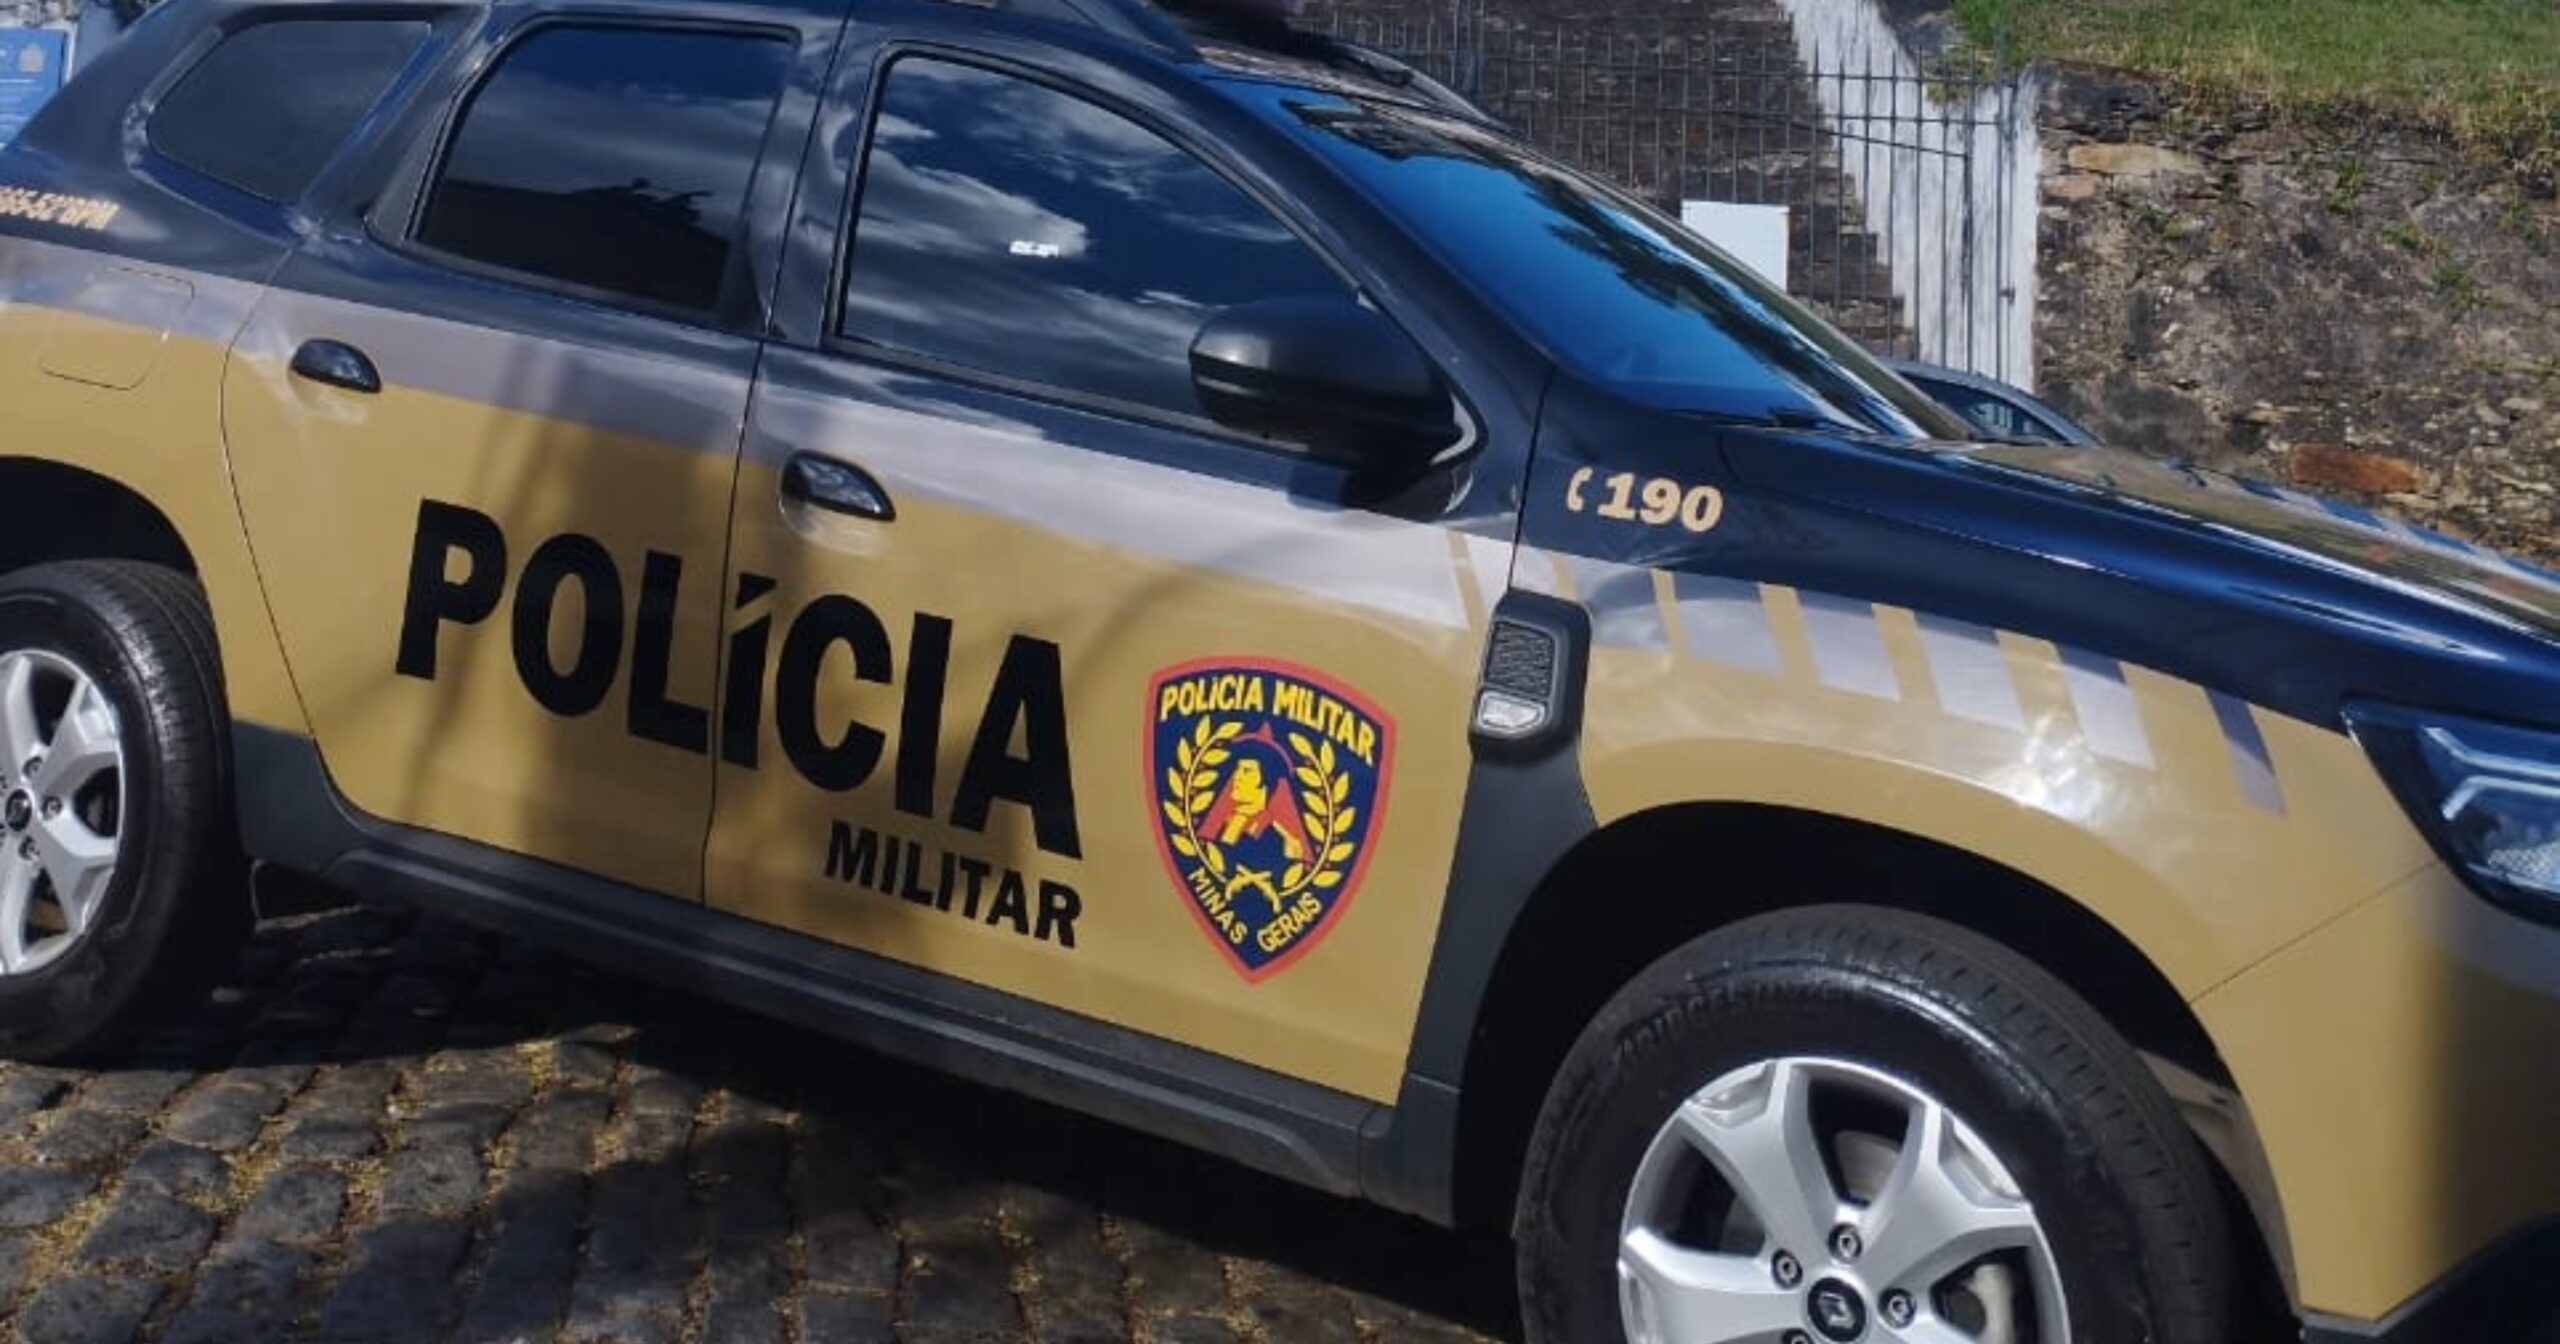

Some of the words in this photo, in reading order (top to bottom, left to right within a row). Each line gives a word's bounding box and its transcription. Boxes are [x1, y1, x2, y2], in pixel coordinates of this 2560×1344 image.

[1597, 471, 1724, 533] 190
[395, 497, 1083, 861] POLÍCIA
[1159, 674, 1264, 722] POLÍCIA
[1272, 679, 1377, 767] MILITAR
[825, 819, 1083, 950] MILITAR
[1187, 866, 1248, 945] MINAS
[1256, 891, 1323, 953] GERAIS
